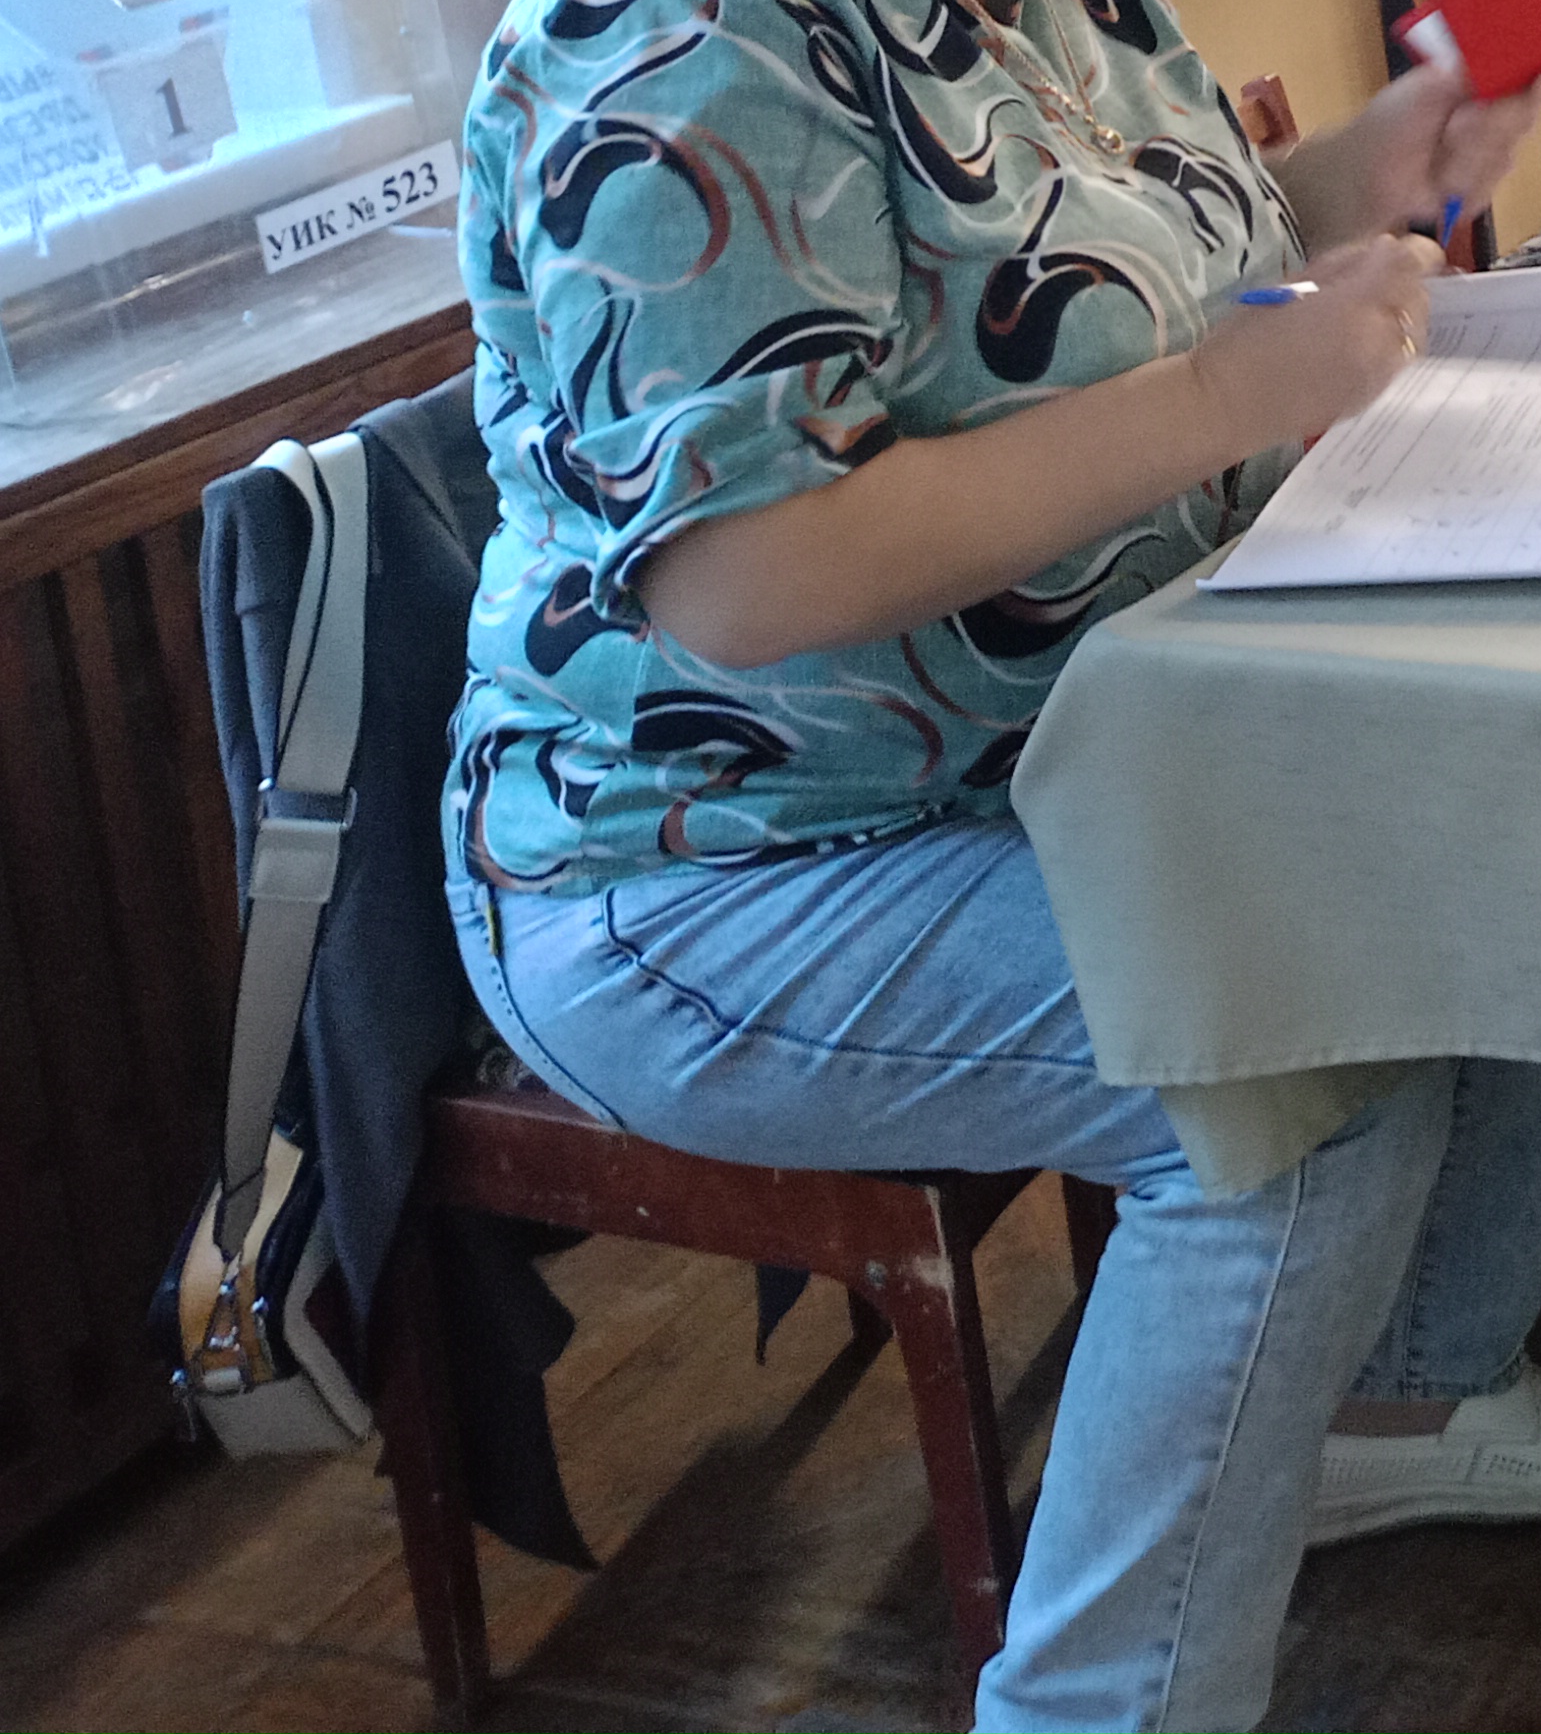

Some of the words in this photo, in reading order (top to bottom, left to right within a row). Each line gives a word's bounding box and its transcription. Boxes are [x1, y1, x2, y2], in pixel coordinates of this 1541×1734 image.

[156, 78, 190, 138] 1
[266, 209, 339, 261] УИК
[347, 196, 376, 229] №
[382, 161, 439, 213] 523
